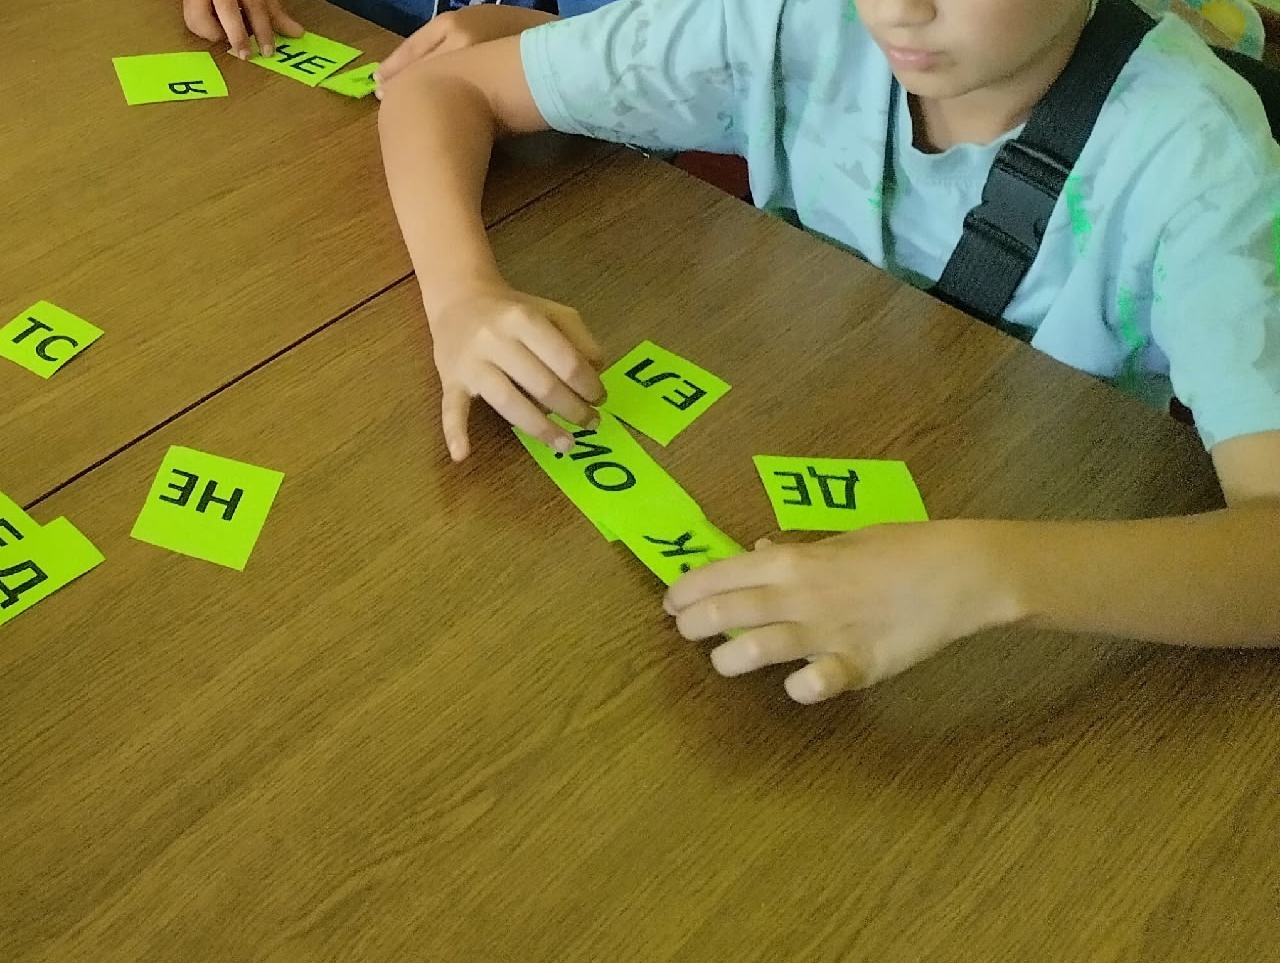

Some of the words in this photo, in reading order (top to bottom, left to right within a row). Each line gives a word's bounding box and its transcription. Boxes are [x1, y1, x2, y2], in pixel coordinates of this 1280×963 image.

[11, 316, 79, 362] ТС
[624, 357, 708, 411] ЕЛ
[159, 468, 244, 521] НЕ
[773, 465, 860, 510] ДЕ
